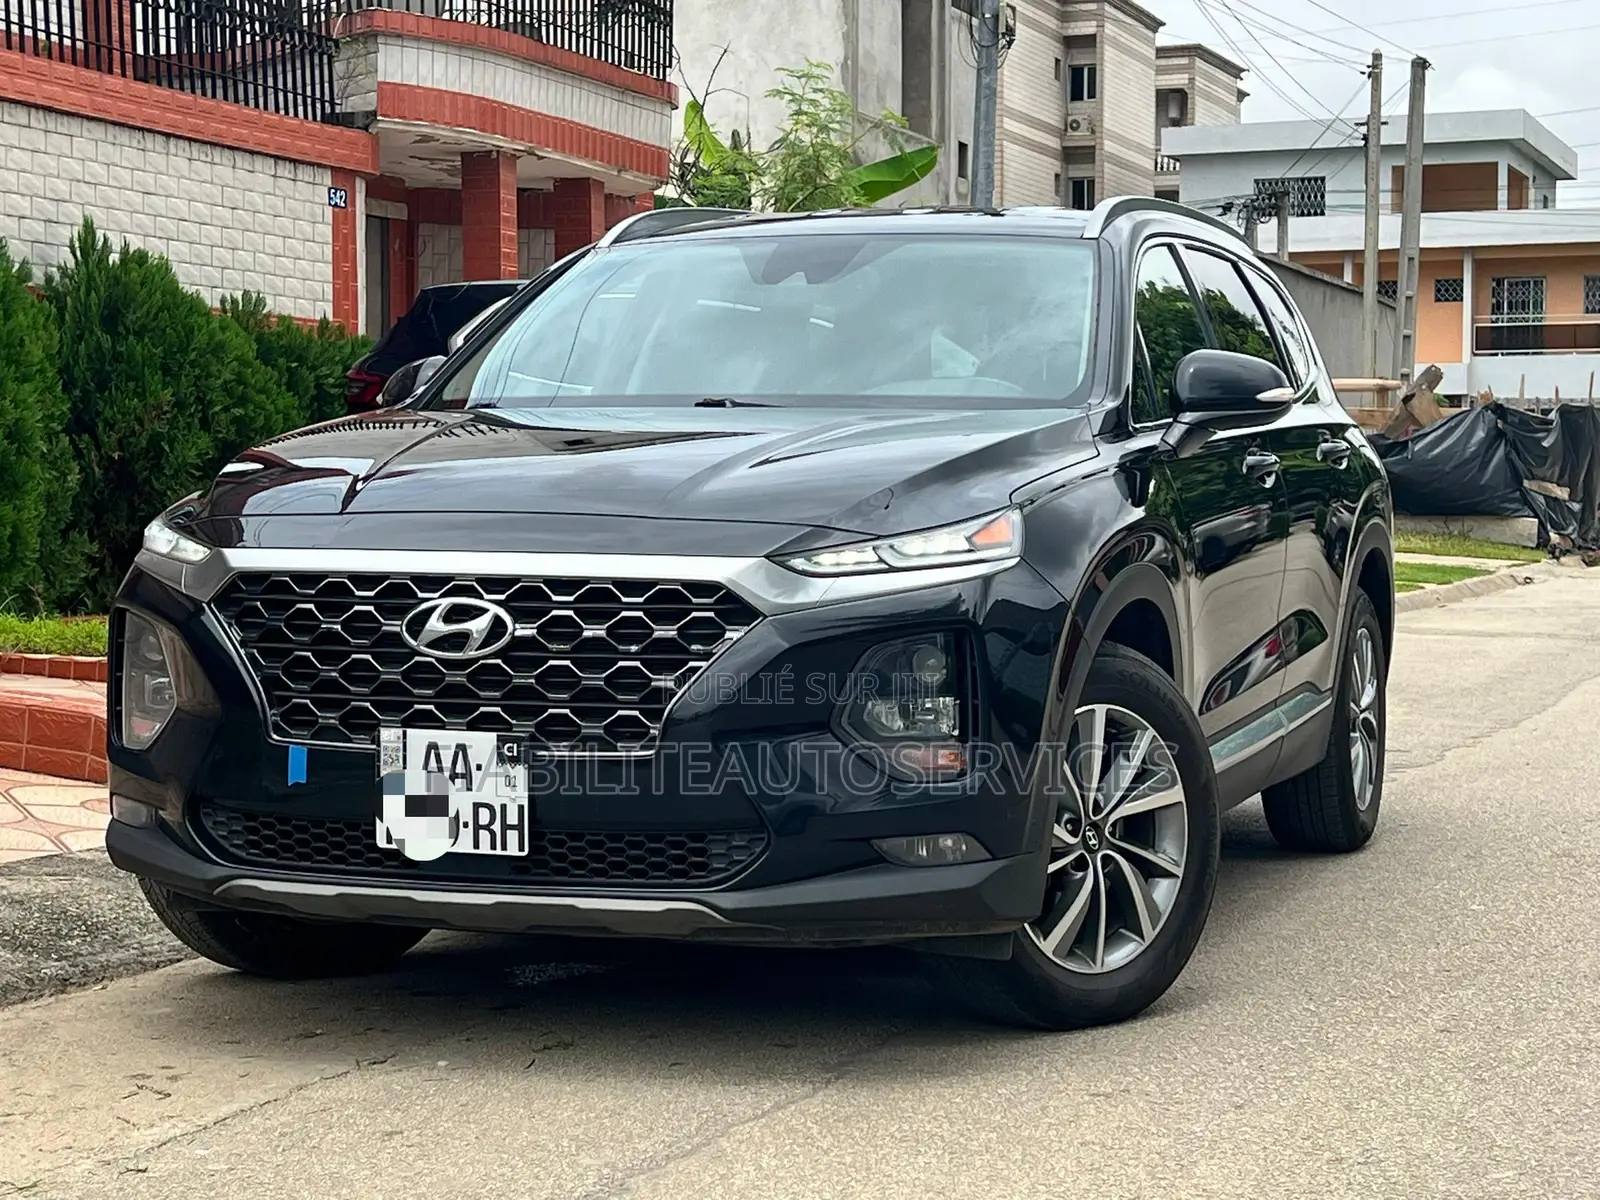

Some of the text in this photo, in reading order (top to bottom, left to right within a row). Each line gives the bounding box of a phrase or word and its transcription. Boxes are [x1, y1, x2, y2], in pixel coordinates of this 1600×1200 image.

[329, 189, 346, 207] 542
[503, 743, 518, 757] CI
[504, 774, 518, 788] 01
